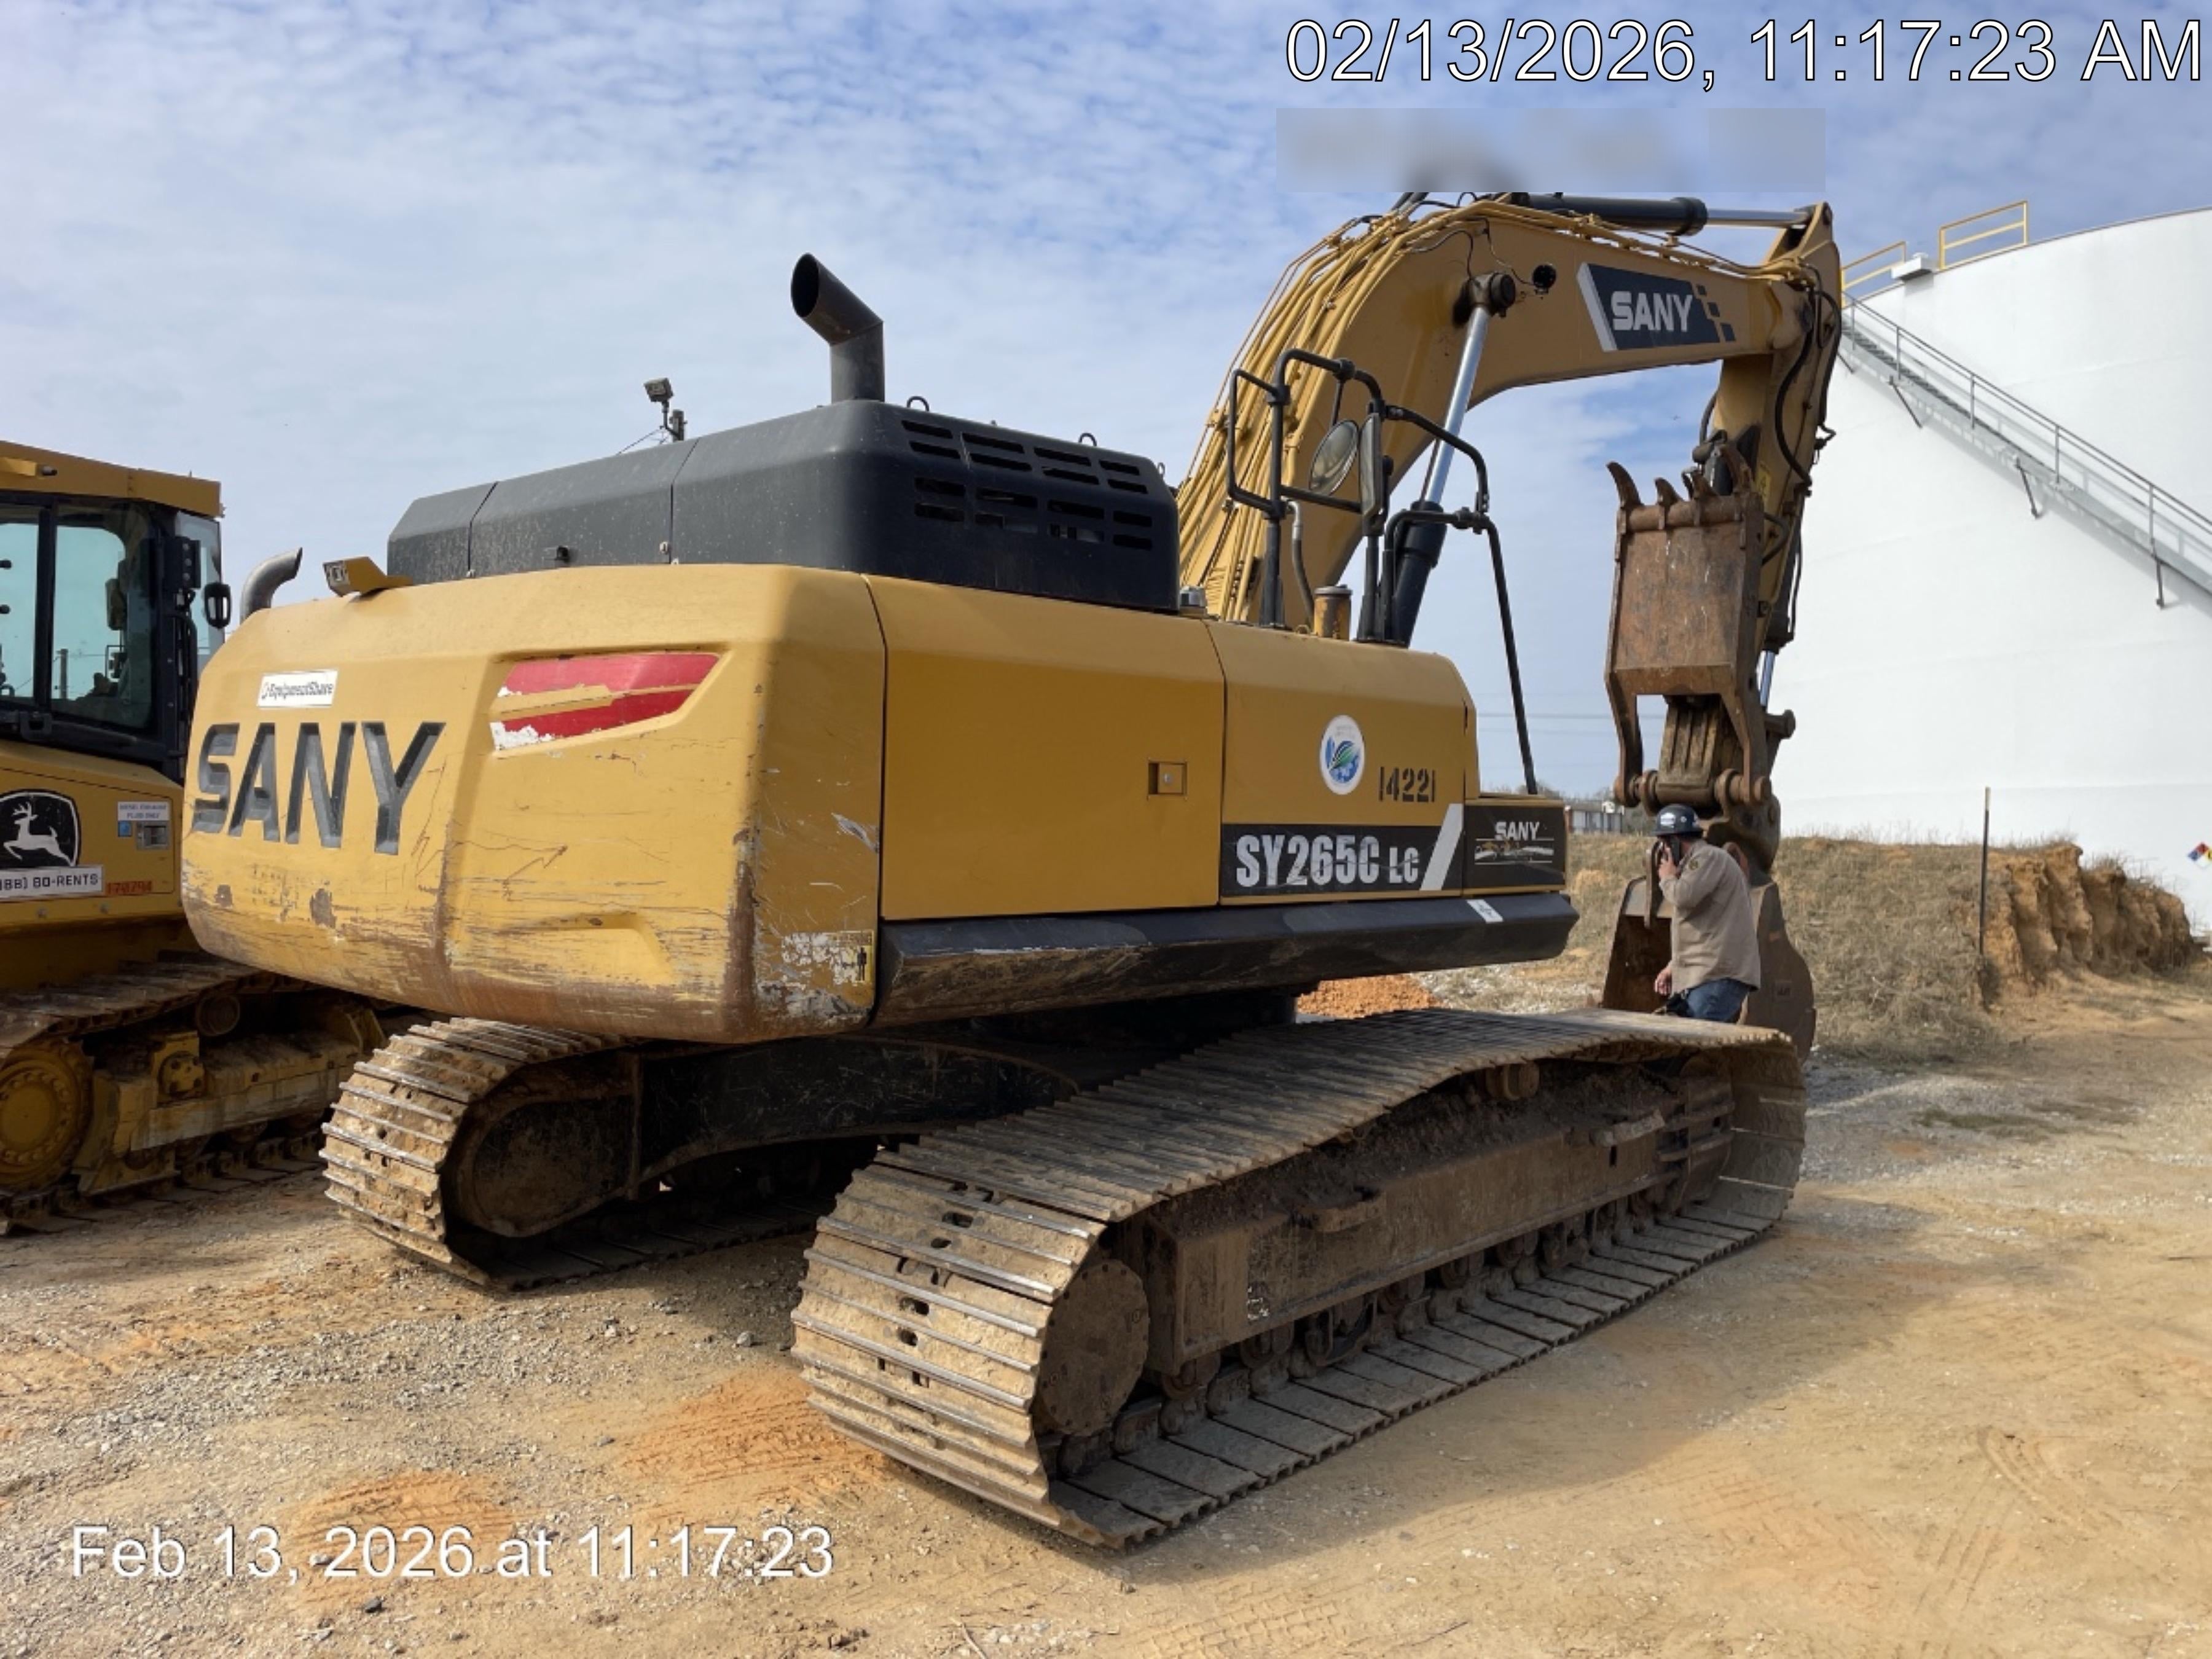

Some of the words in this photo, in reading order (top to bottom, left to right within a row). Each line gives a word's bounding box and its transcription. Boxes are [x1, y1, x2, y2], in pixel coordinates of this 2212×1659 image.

[1610, 290, 1693, 332] SANY
[192, 721, 447, 855] SANY
[1494, 821, 1540, 841] SANY
[33, 873, 98, 888] 80-RENTS
[1236, 834, 1380, 887] SY265C
[1389, 846, 1419, 884] LC
